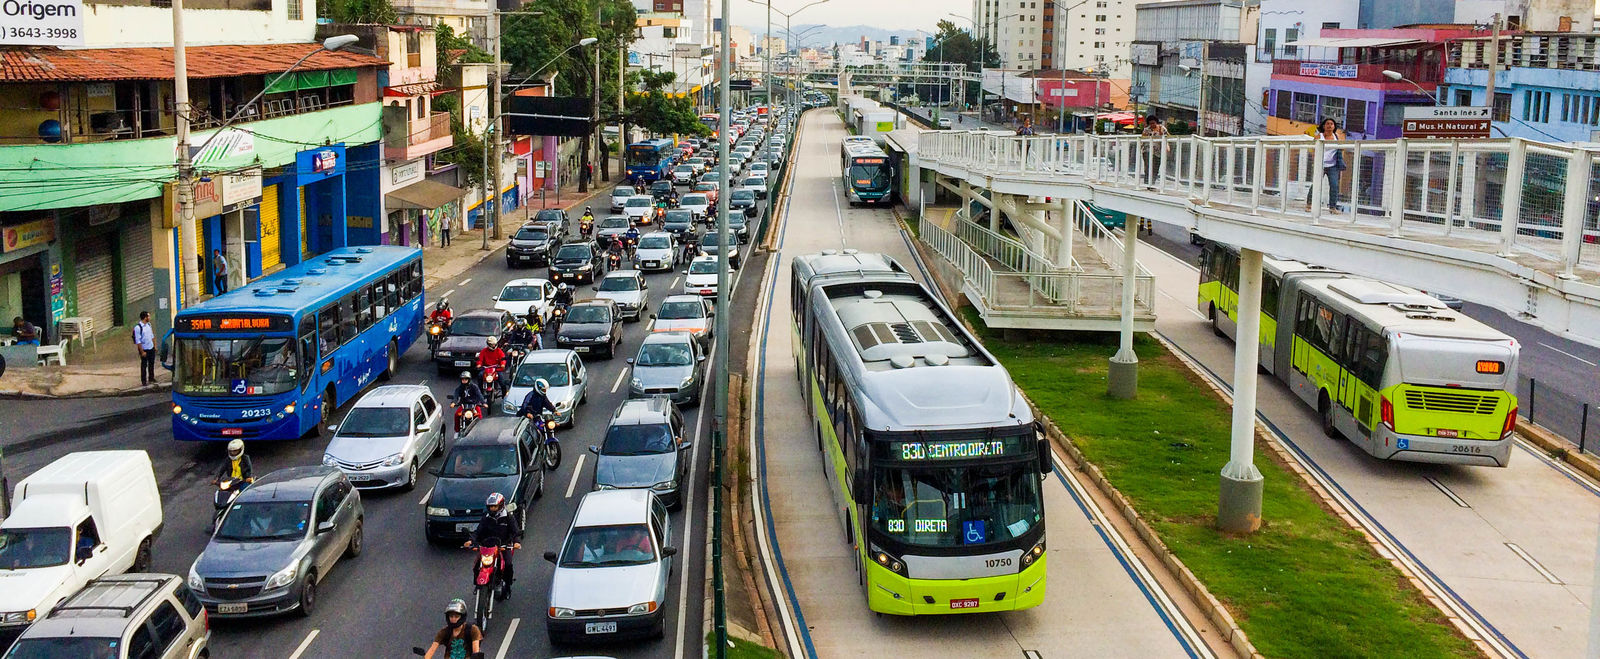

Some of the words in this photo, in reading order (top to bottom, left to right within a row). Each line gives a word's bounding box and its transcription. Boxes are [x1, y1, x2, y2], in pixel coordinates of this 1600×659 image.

[3, 0, 76, 20] Origem
[10, 27, 77, 39] 3643-3998
[242, 408, 272, 418] 20233
[928, 443, 967, 458] CENTRO
[968, 441, 1004, 457] DIRETA
[1452, 446, 1480, 454] 20616
[915, 519, 948, 532] DIRETA
[984, 558, 1012, 568] 10750
